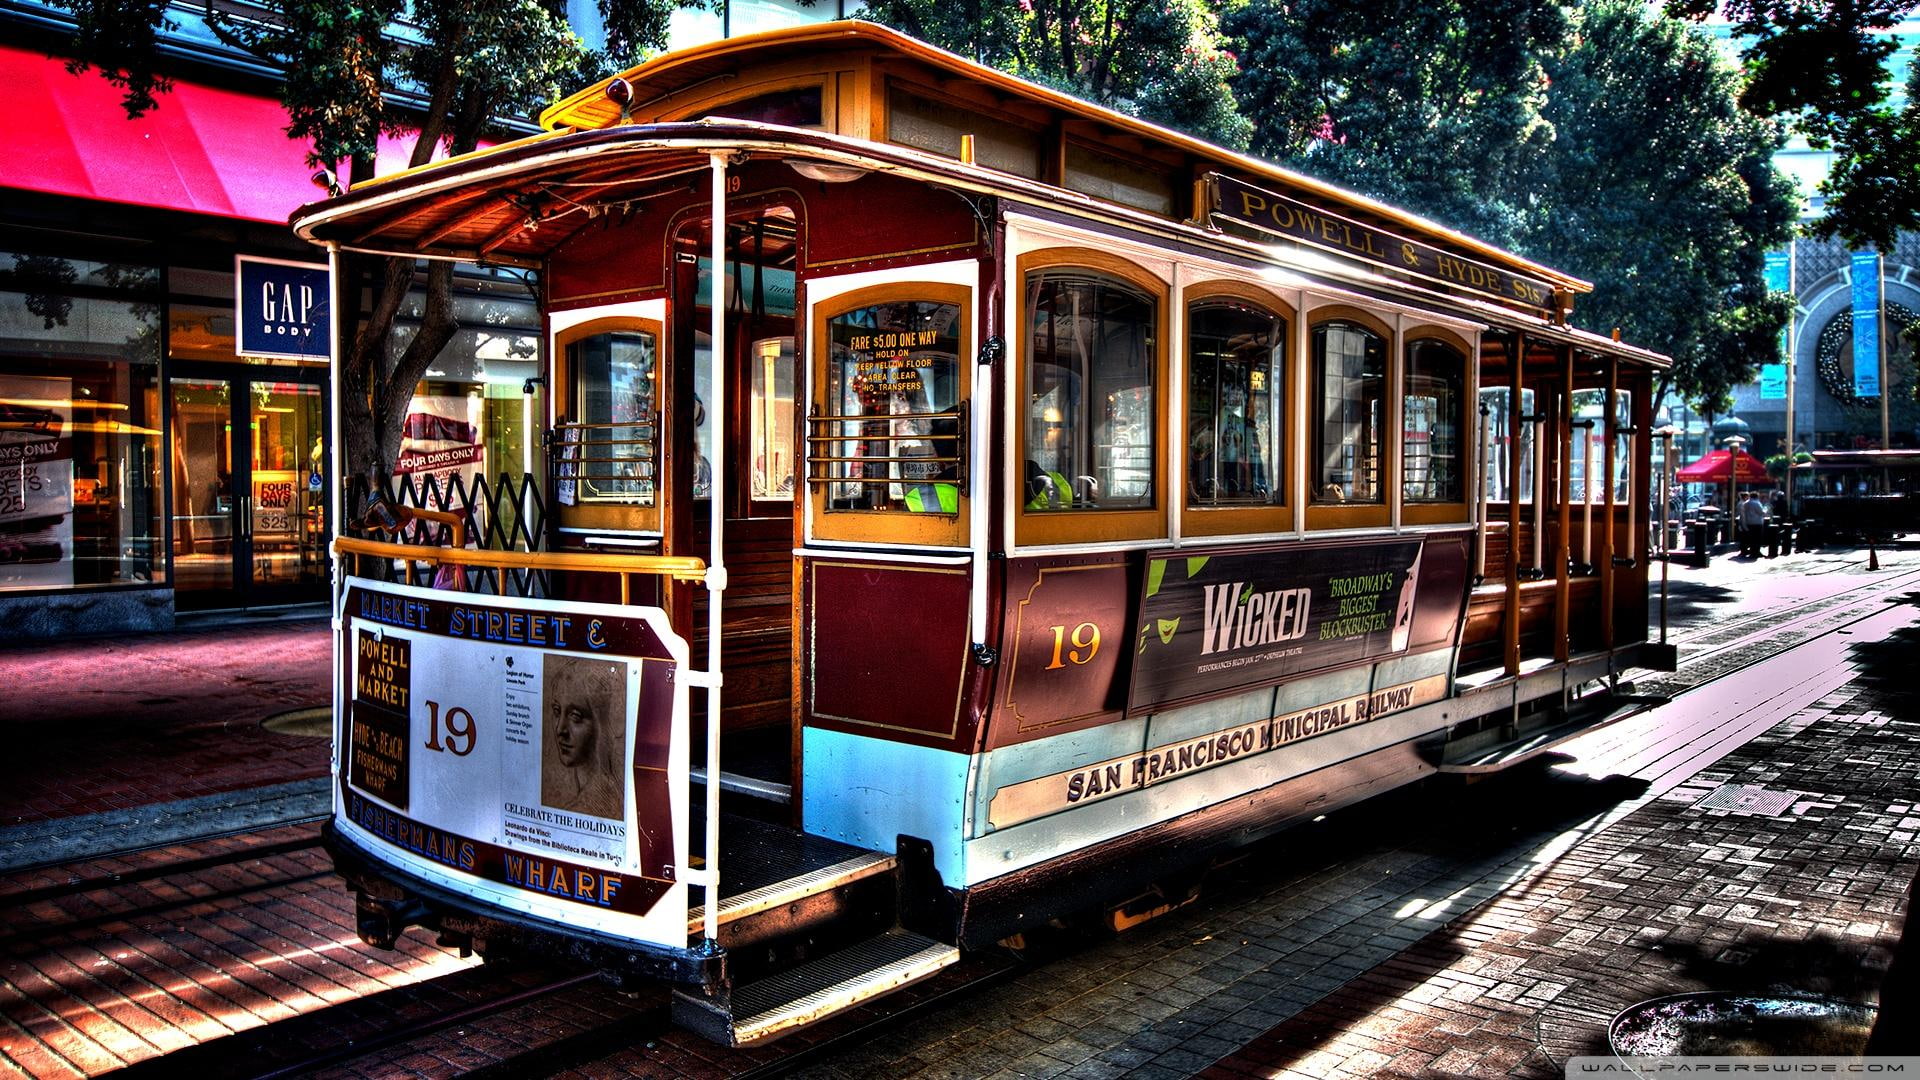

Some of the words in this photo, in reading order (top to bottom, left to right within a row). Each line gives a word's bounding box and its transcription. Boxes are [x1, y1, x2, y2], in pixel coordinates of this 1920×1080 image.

[726, 176, 741, 192] 19
[1239, 190, 1388, 260] POWELL
[1401, 243, 1421, 267] &
[1437, 255, 1501, 291] HYDE
[1512, 278, 1546, 306] Sts.
[263, 281, 313, 324] GAP
[264, 325, 312, 336] BODY
[850, 335, 871, 351] FARE
[873, 333, 897, 349] $5.00
[899, 332, 917, 347] ONE
[919, 330, 937, 346] WAY
[875, 350, 896, 359] HOLD
[898, 349, 909, 357] ON
[876, 360, 904, 370] YELLOW
[906, 358, 932, 368] FLOOR
[868, 373, 888, 382] AREA
[891, 371, 916, 380] CLEAR
[879, 381, 921, 391] TRANSFERS
[24, 441, 60, 456] ONLY
[400, 456, 427, 470] FOUR
[427, 451, 451, 465] DAYS
[451, 447, 475, 460] ONLY
[261, 483, 292, 491] FOUR
[261, 490, 292, 500] DAYS
[260, 498, 291, 508] ONLY
[260, 516, 289, 529] $25
[1338, 594, 1380, 617] BIGGEST
[361, 591, 430, 629] MARKET
[450, 606, 571, 647] STREET
[360, 636, 408, 669] POWELL
[1045, 621, 1101, 671] 19
[369, 662, 394, 682] AND
[358, 673, 408, 707] MARKET
[424, 700, 477, 757] 19
[354, 721, 370, 749] HYDE
[380, 730, 403, 761] BEACH
[1066, 762, 1122, 802] SAN
[1131, 729, 1255, 790] FRANCISCO
[1259, 702, 1351, 752] MUNICIPAL
[1355, 685, 1415, 722] RAILWAY
[357, 749, 397, 780] FISHERMANS
[504, 802, 553, 823] CELEBRATE
[554, 812, 574, 827] THE
[575, 818, 625, 837] HOLIDAYS
[505, 820, 528, 833] Leonardo
[528, 826, 536, 834] da
[351, 794, 476, 871] FISHERMANS
[504, 853, 622, 906] WHARF
[505, 829, 528, 842] Drawings
[528, 835, 541, 844] from
[541, 838, 551, 847] the
[552, 840, 580, 854] Biblioteca
[581, 847, 598, 858] Reale
[599, 851, 605, 859] in
